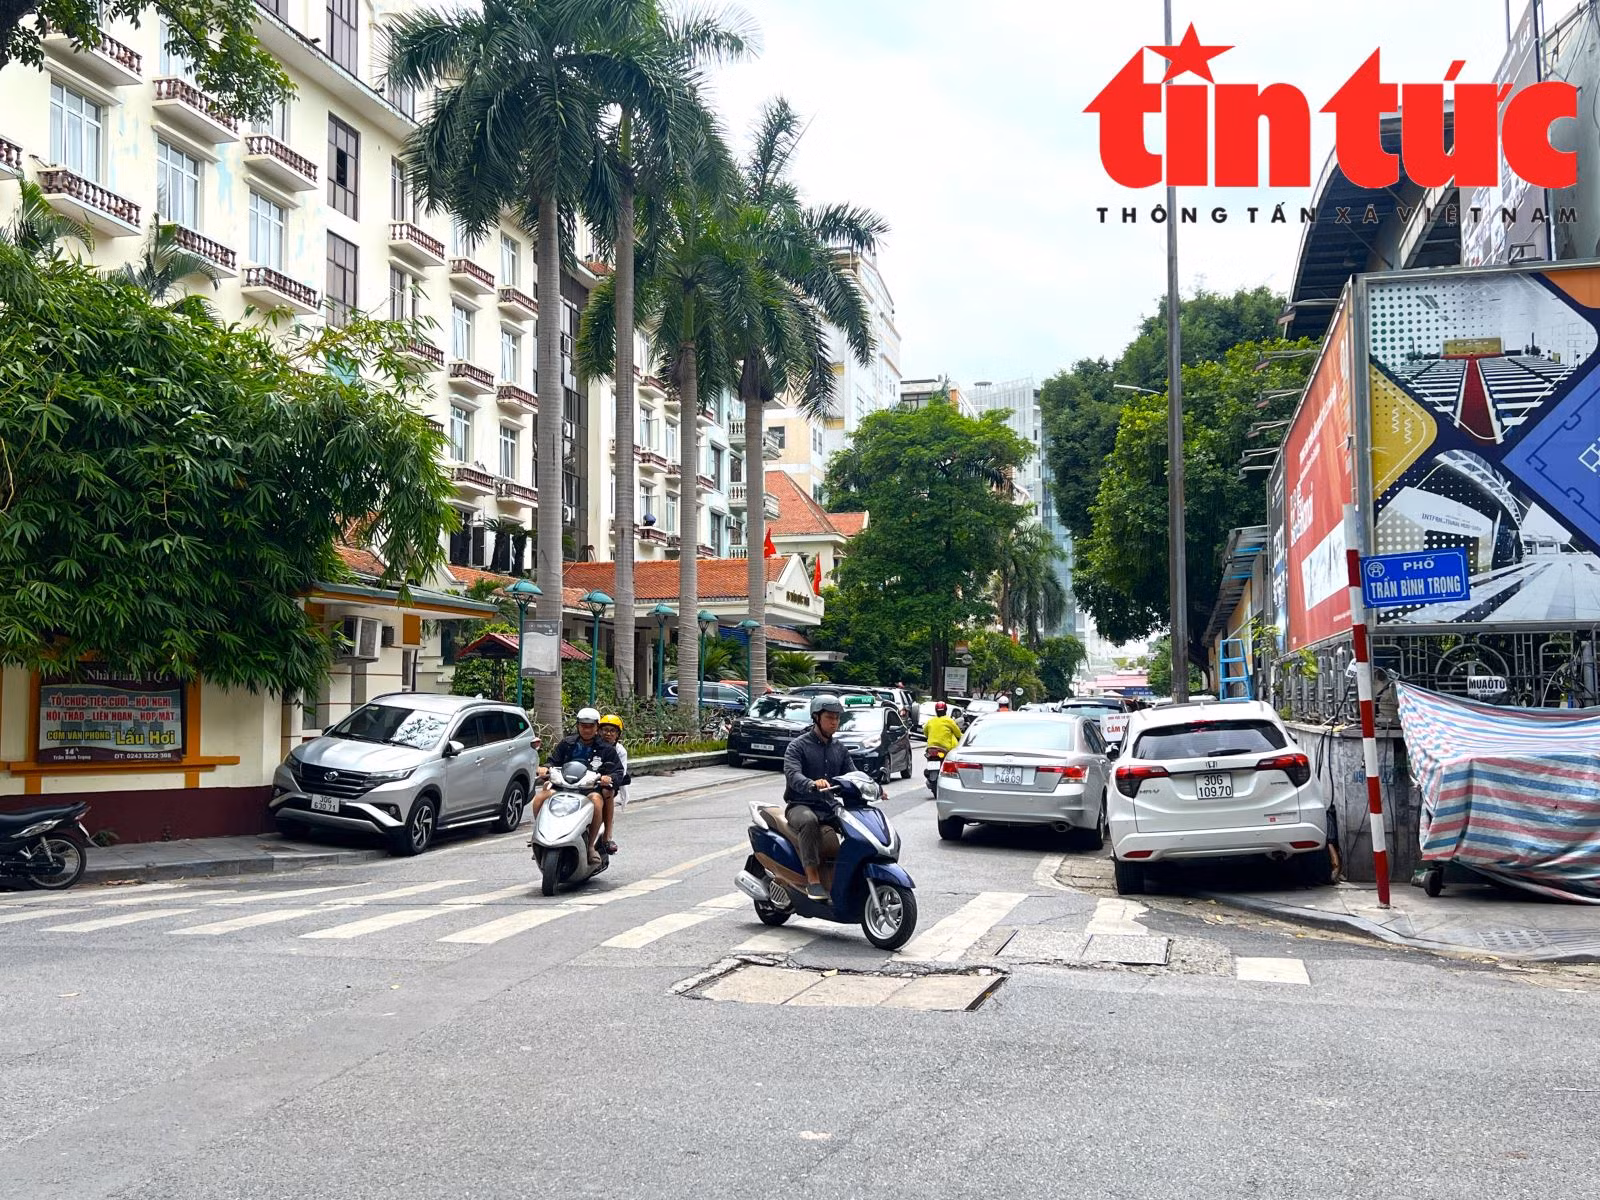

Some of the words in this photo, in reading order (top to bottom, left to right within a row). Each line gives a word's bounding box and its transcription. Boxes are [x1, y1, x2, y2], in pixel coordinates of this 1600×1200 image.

[1403, 555, 1435, 571] PHỐ
[1371, 576, 1398, 599] TRẦN
[1401, 576, 1425, 597] BÌNH
[1428, 575, 1461, 597] TRỌNG
[116, 727, 145, 746] Lẩu
[149, 730, 176, 745] Hơi
[1204, 775, 1223, 786] 30G
